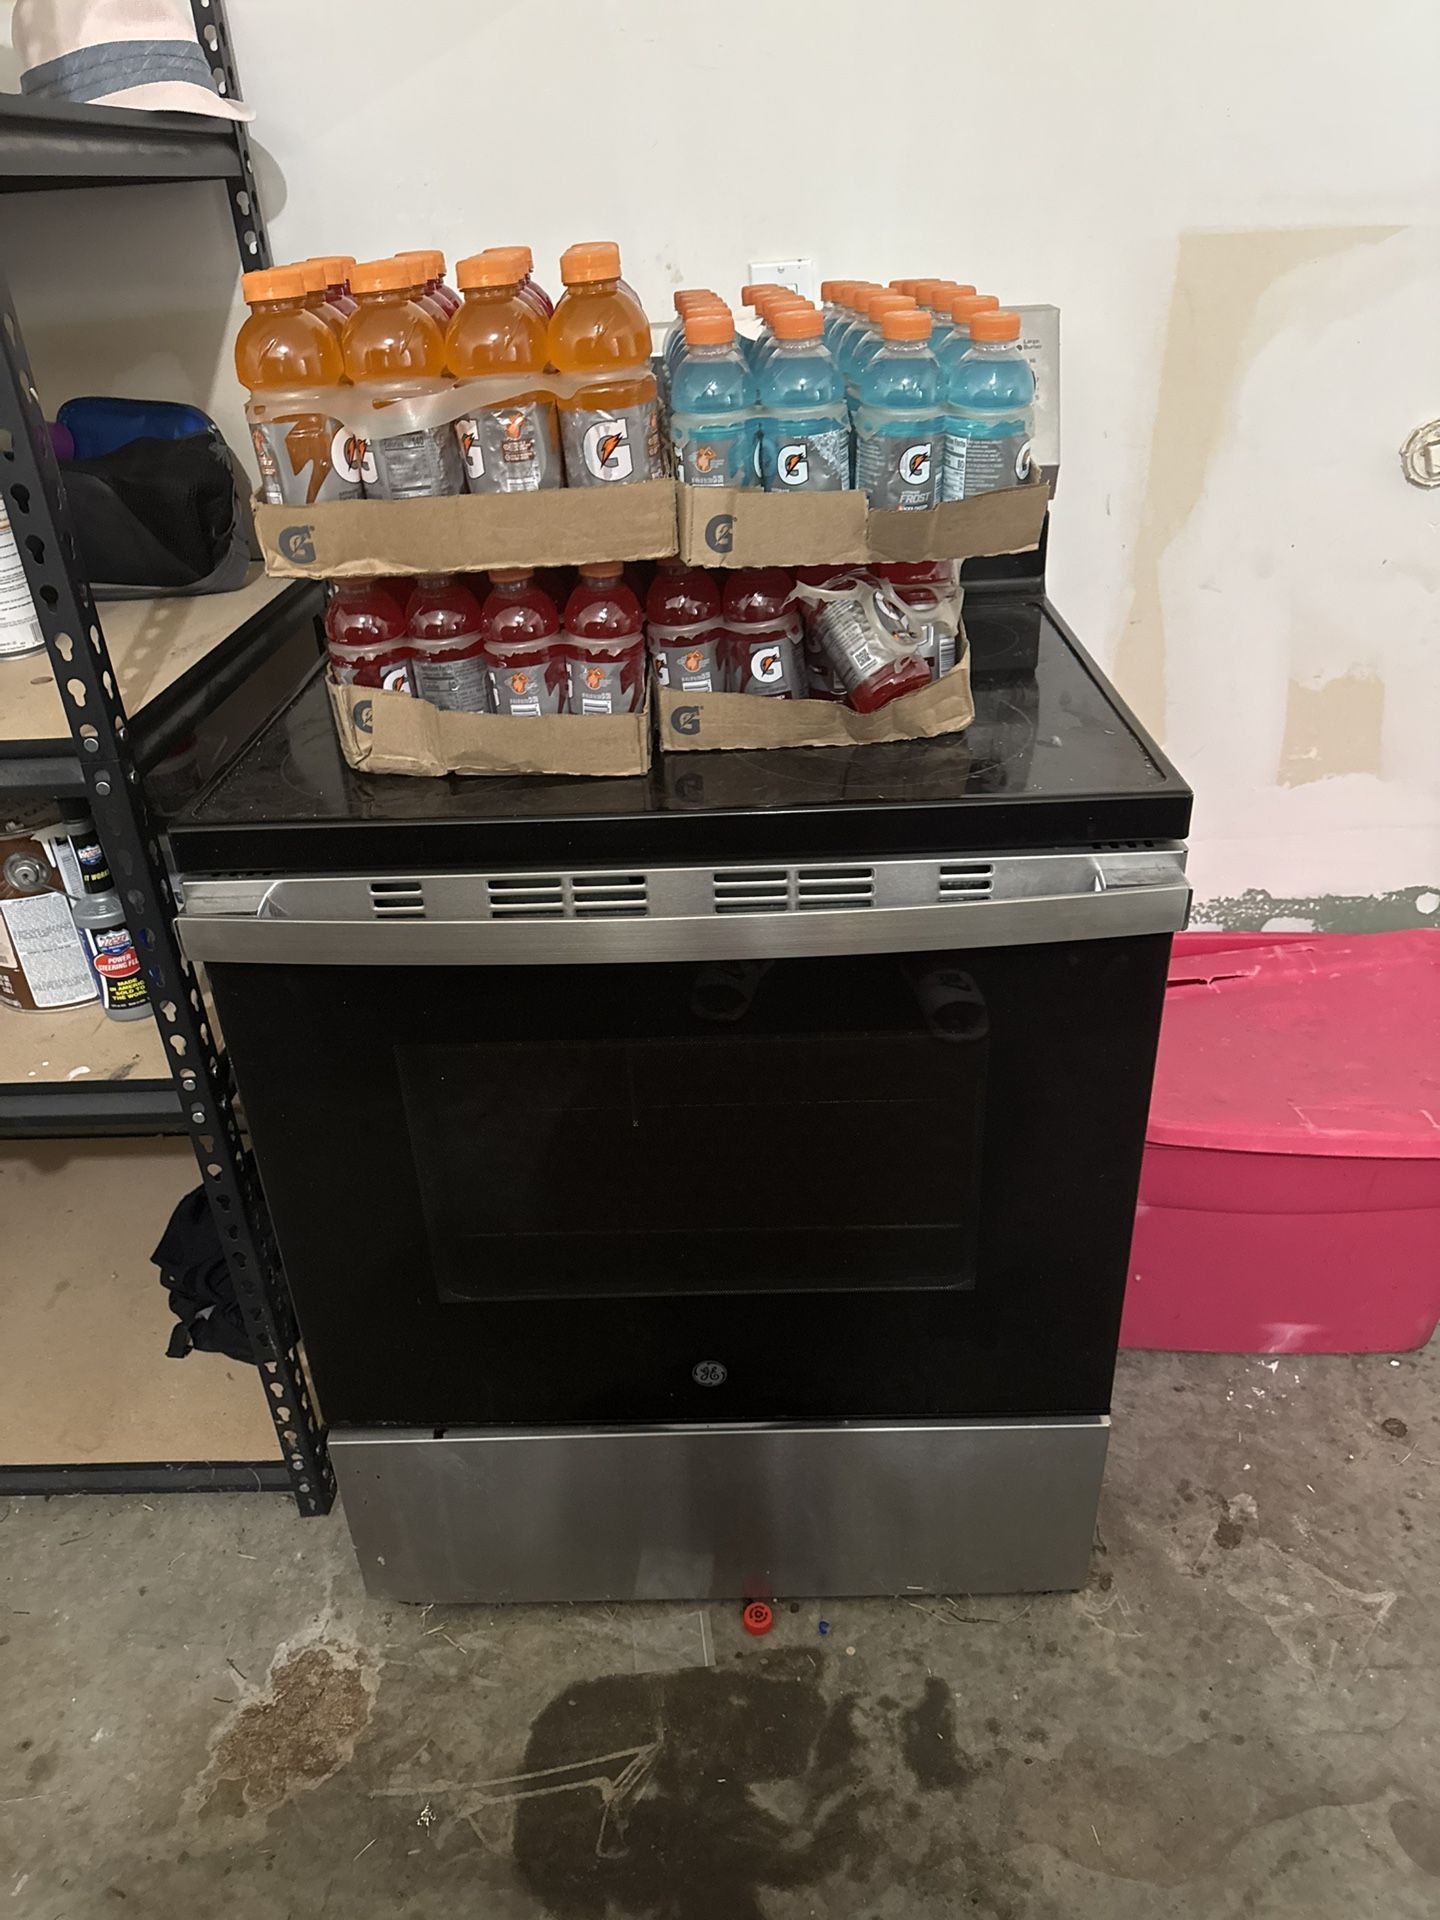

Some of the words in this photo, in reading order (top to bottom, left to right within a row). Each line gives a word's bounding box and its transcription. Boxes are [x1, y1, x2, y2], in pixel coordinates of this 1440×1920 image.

[453, 418, 485, 479] G
[582, 417, 633, 482] G
[899, 442, 932, 486] G
[777, 443, 810, 486] G
[900, 491, 932, 504] FROST
[278, 524, 317, 564] G
[704, 513, 733, 554] G
[750, 645, 784, 684] G
[670, 705, 701, 736] G
[98, 961, 128, 973] STEERING
[107, 953, 132, 965] POWER
[112, 993, 127, 1001] THE
[127, 989, 148, 1000] WORL
[115, 988, 135, 996] SOLD
[117, 978, 138, 987] MADE
[118, 980, 146, 992] AMERIC
